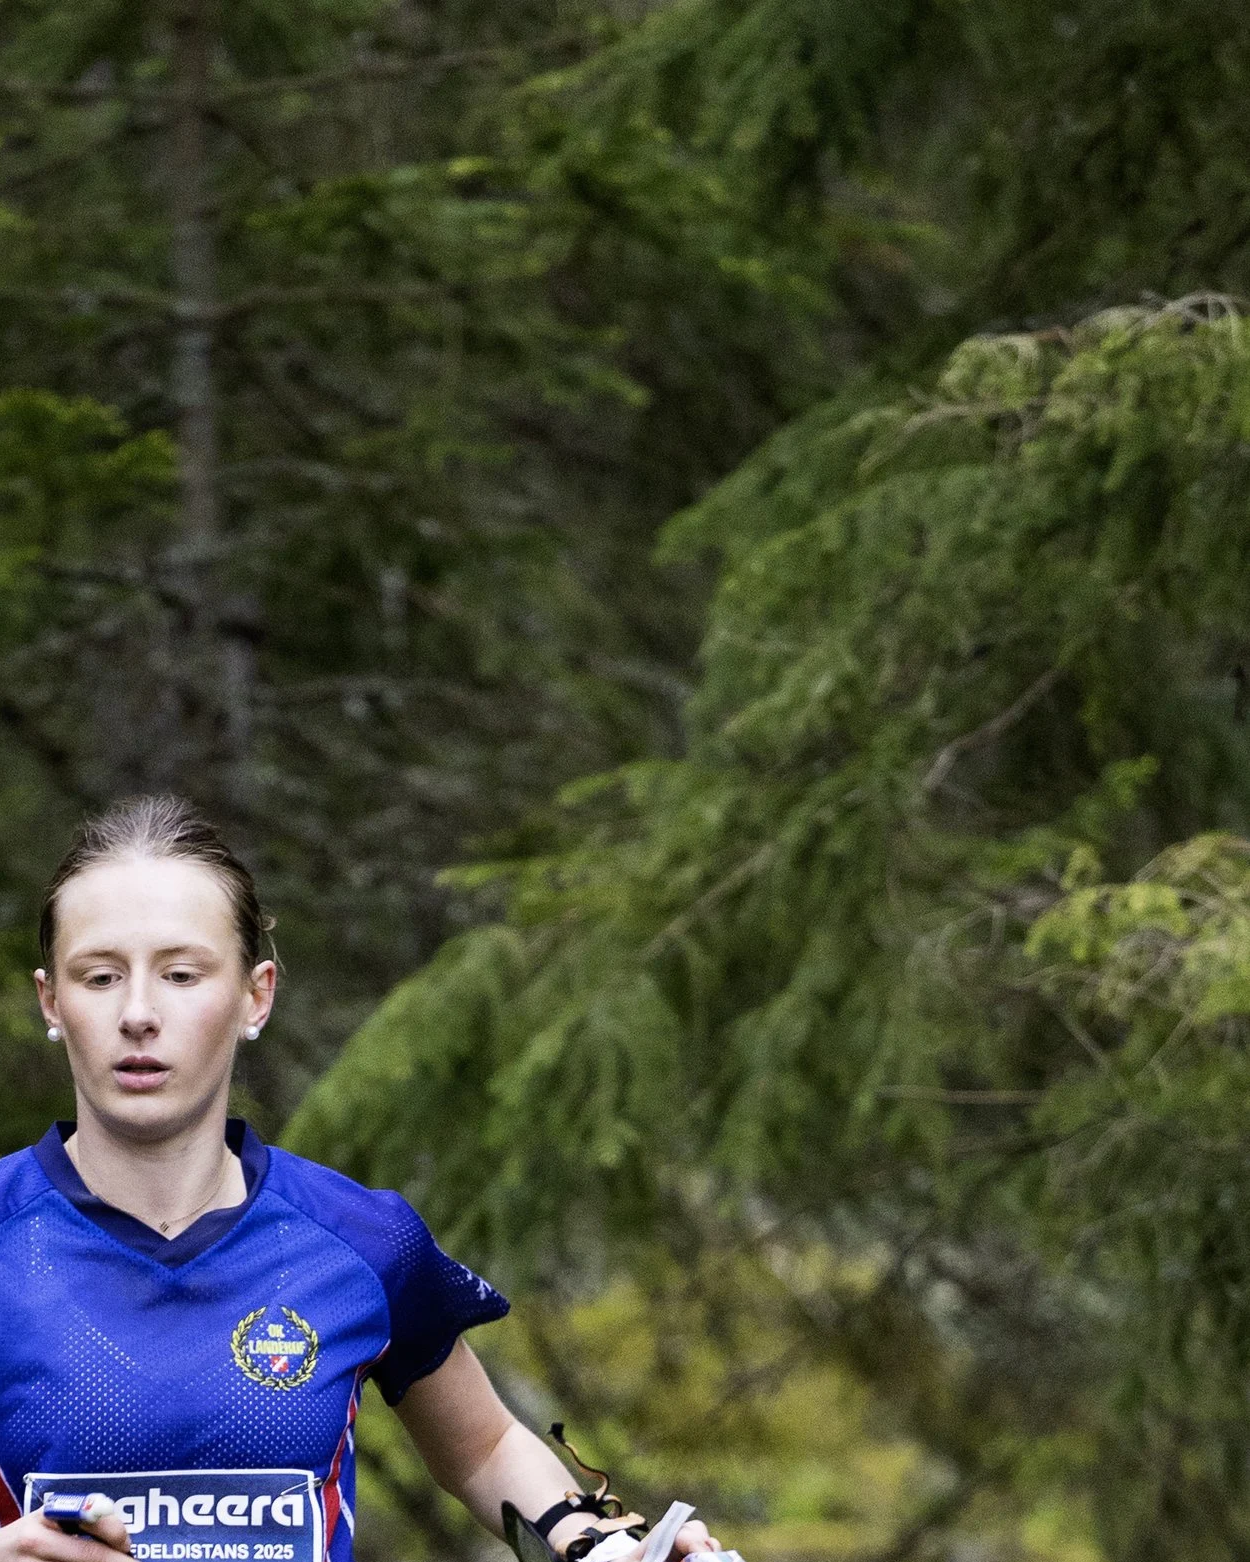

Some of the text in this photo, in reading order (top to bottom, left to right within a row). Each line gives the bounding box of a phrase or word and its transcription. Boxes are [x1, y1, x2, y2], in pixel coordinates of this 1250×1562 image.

[44, 1487, 304, 1535] gheera
[129, 1543, 295, 1559] EDELDISTANS 2025
